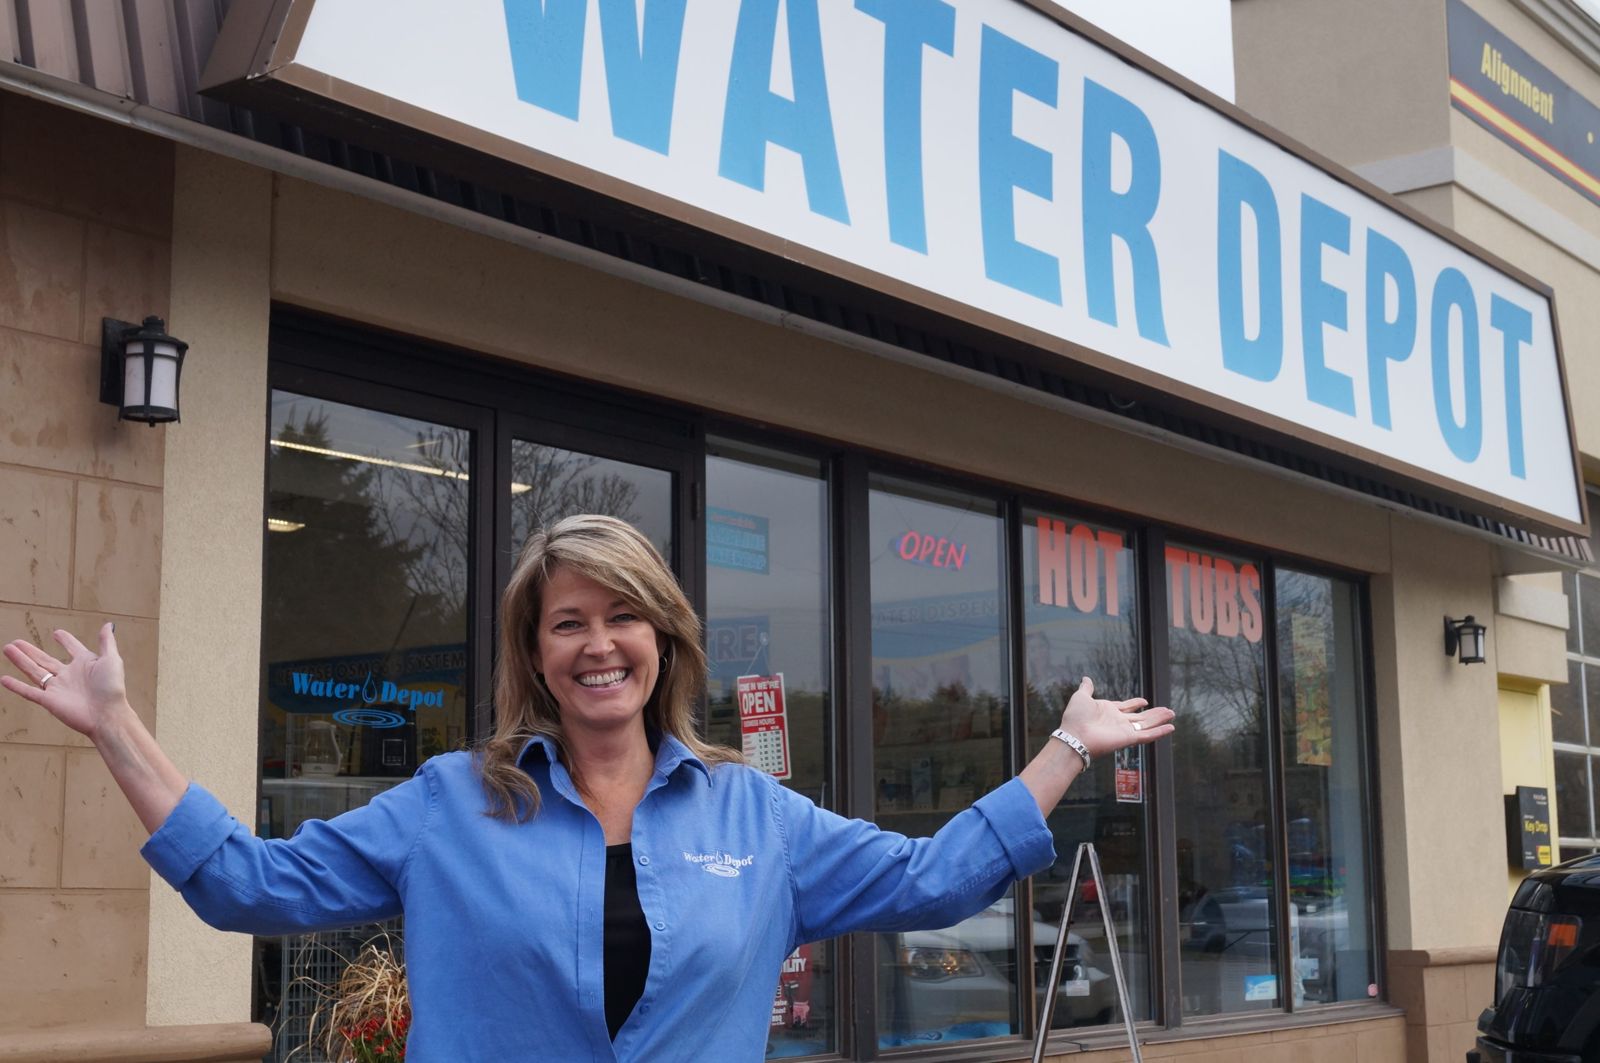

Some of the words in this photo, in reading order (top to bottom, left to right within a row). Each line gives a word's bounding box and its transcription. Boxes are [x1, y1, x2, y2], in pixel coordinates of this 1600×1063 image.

[1481, 42, 1554, 124] Alignment
[1217, 148, 1532, 480] DEPOT
[900, 530, 967, 570] OPEN
[1037, 516, 1123, 617] HOT
[1165, 546, 1263, 643] TUBS
[292, 671, 360, 699] Water
[381, 680, 446, 711] Depot
[742, 691, 776, 715] OPEN
[1524, 820, 1536, 835] Key
[1535, 820, 1549, 835] Drop
[683, 851, 716, 863] Water
[724, 854, 754, 868] Depot
